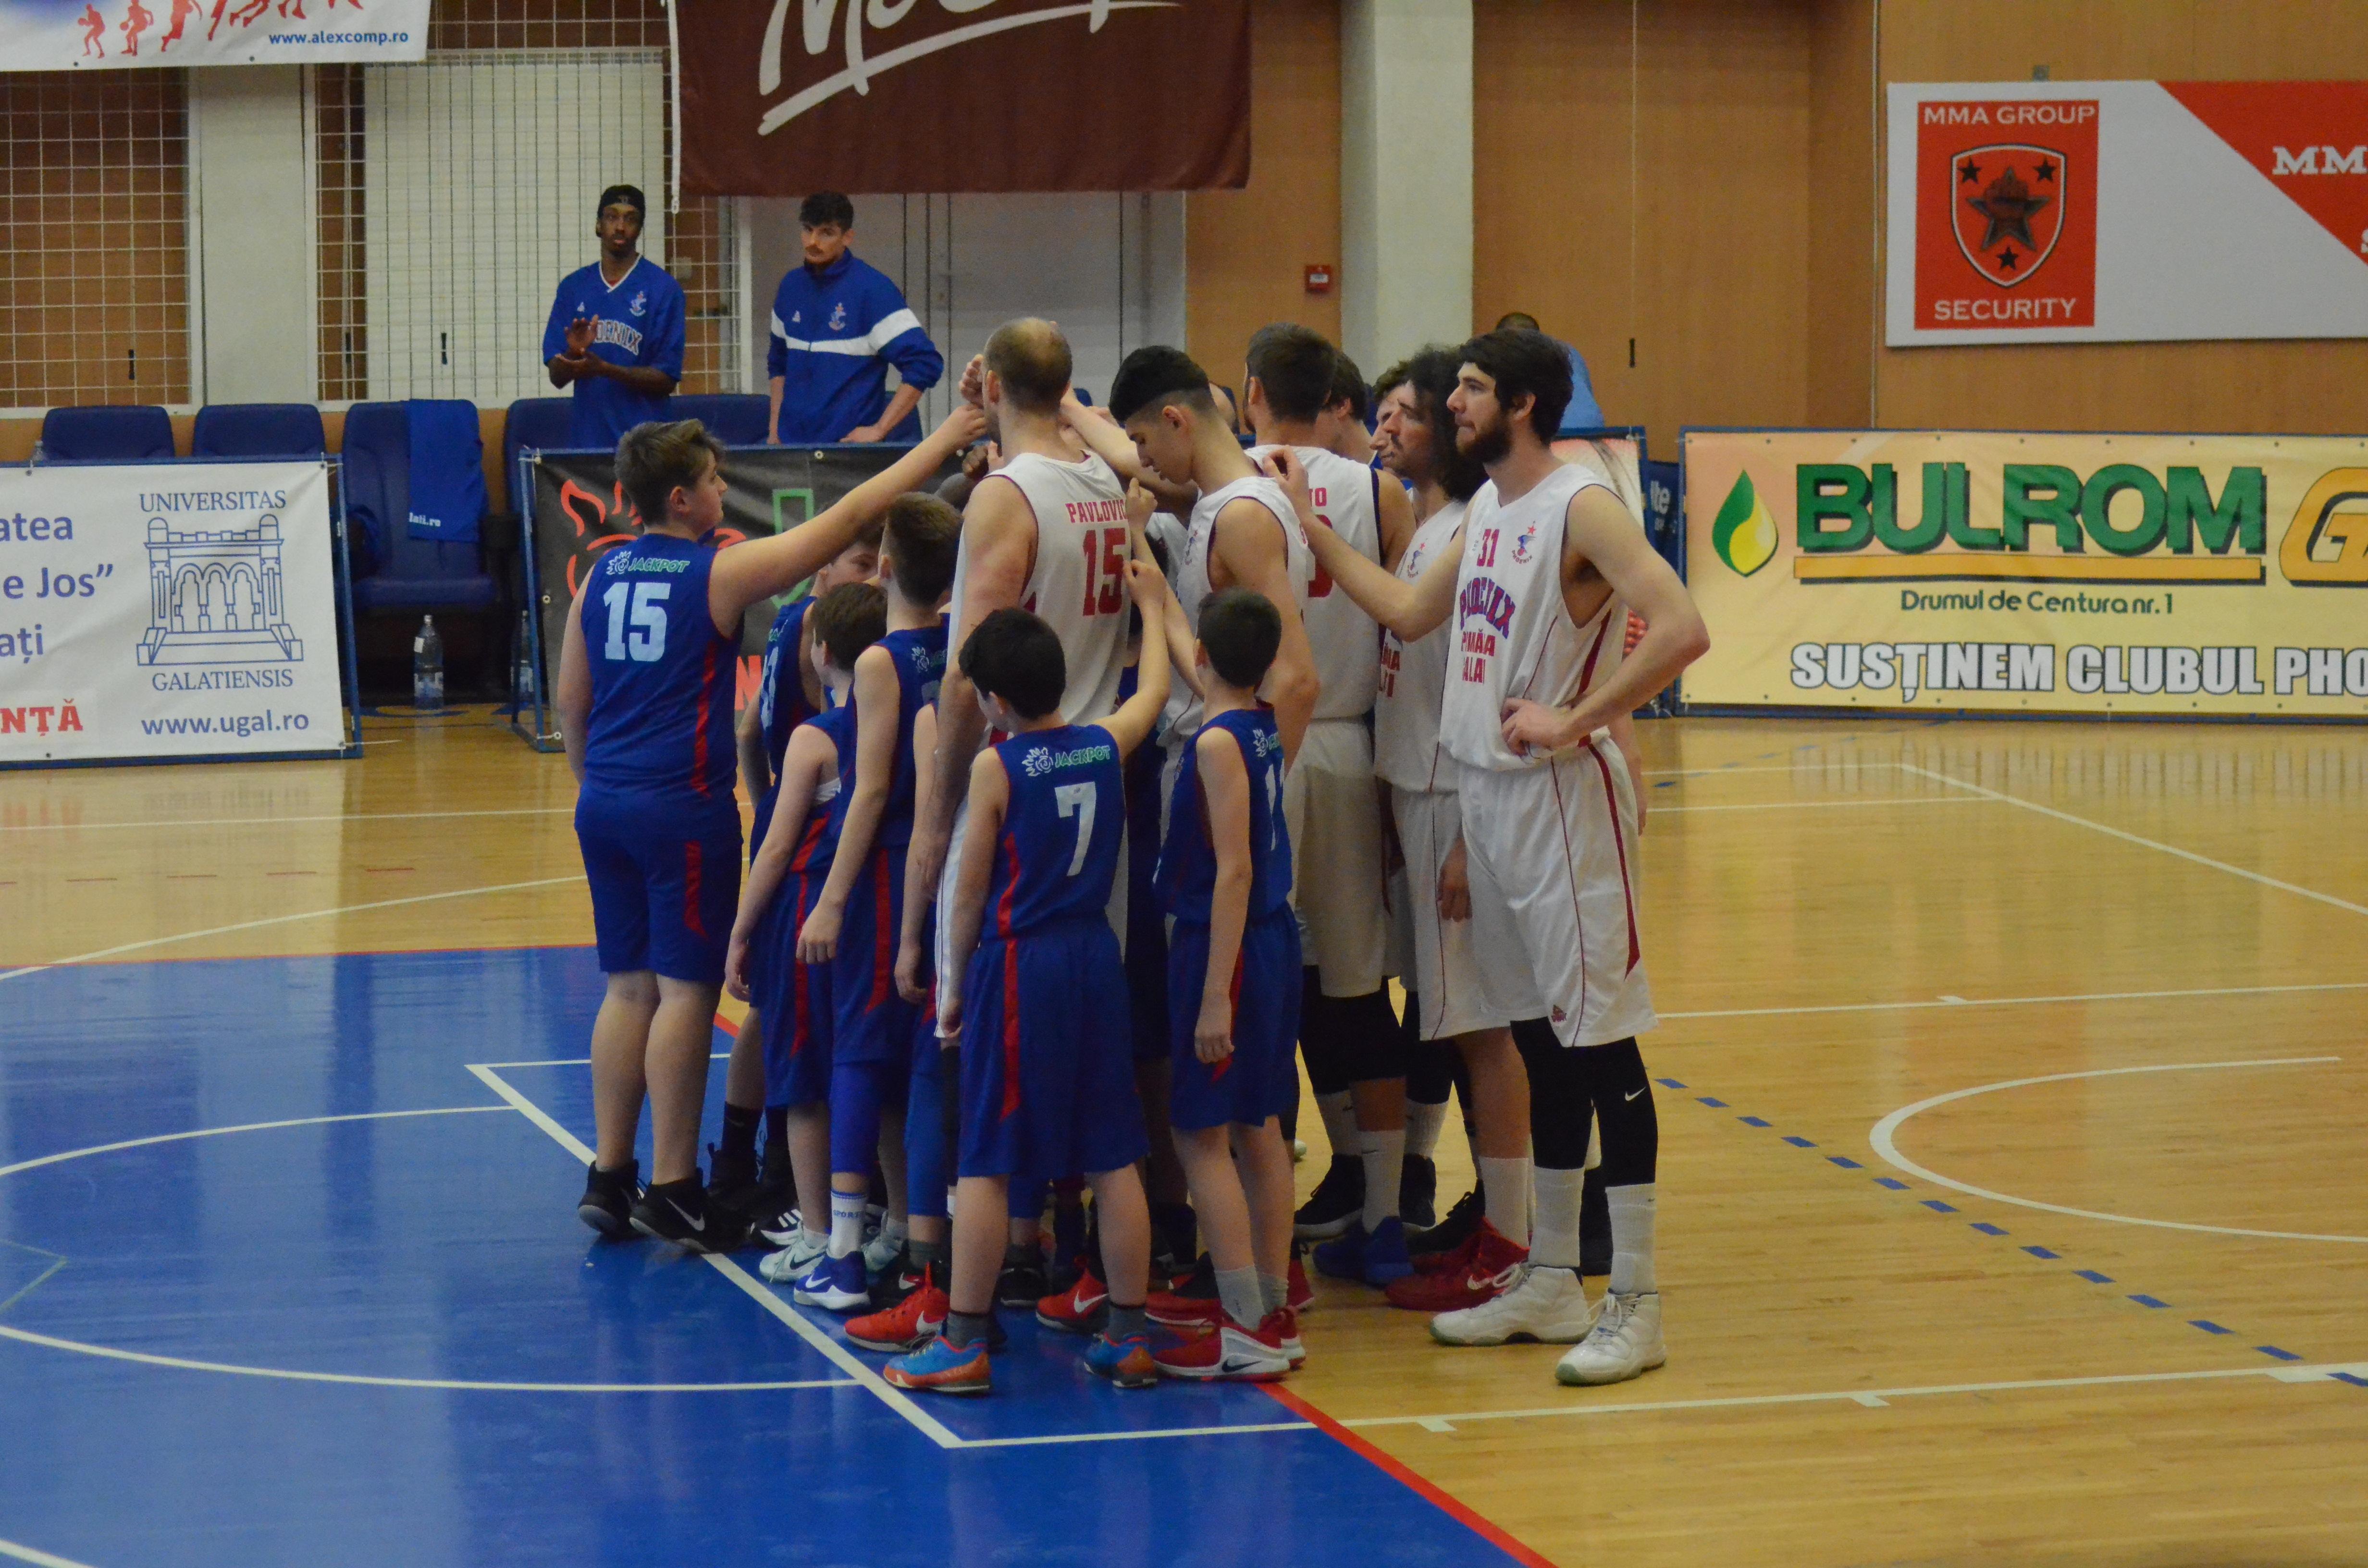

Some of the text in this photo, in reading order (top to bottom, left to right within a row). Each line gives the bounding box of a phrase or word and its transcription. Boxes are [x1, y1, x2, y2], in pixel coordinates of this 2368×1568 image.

[269, 30, 408, 46] www.alexcomp.ro
[1924, 105, 2096, 125] MMA GROUP
[1934, 297, 2076, 321] SECURITY
[139, 490, 287, 513] UNIVERSITAS
[1796, 462, 2267, 556] BULROM
[1476, 528, 1500, 568] 31
[628, 557, 691, 573] JACKPOT
[1082, 527, 1126, 616] 15
[1901, 589, 1984, 612] Drumul
[1988, 589, 2022, 612] de
[2026, 590, 2128, 614] Centura
[603, 582, 671, 662] 15
[152, 669, 294, 691] GALATIENSIS
[1790, 642, 2368, 703] SUSȚINEM CLUBUL PHO
[141, 709, 309, 737] www.ugal.ro
[1055, 745, 1111, 768] JACKPOT
[1054, 781, 1097, 877] 7
